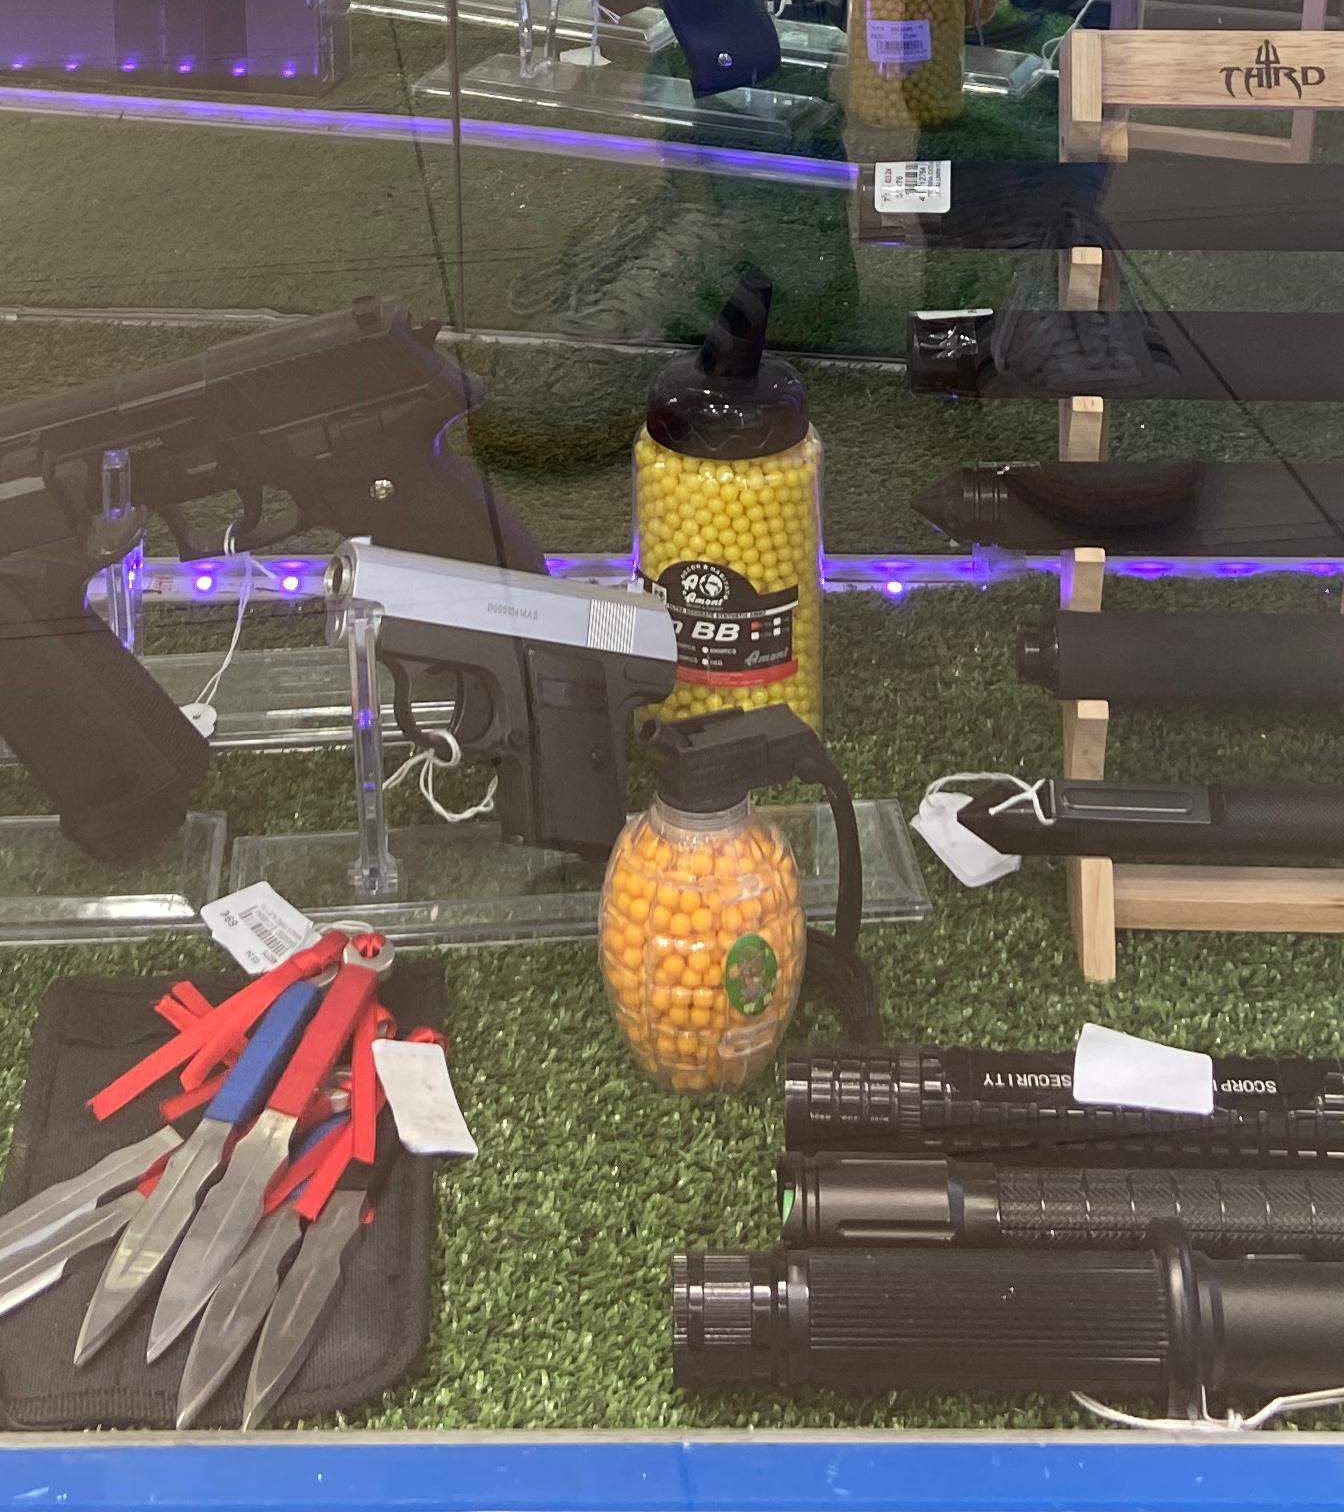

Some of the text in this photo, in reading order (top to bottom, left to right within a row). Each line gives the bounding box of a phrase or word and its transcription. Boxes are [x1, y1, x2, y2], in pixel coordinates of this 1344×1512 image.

[1219, 39, 1326, 100] THIRD
[691, 620, 741, 642] BB
[984, 1073, 1072, 1088] SECURITY
